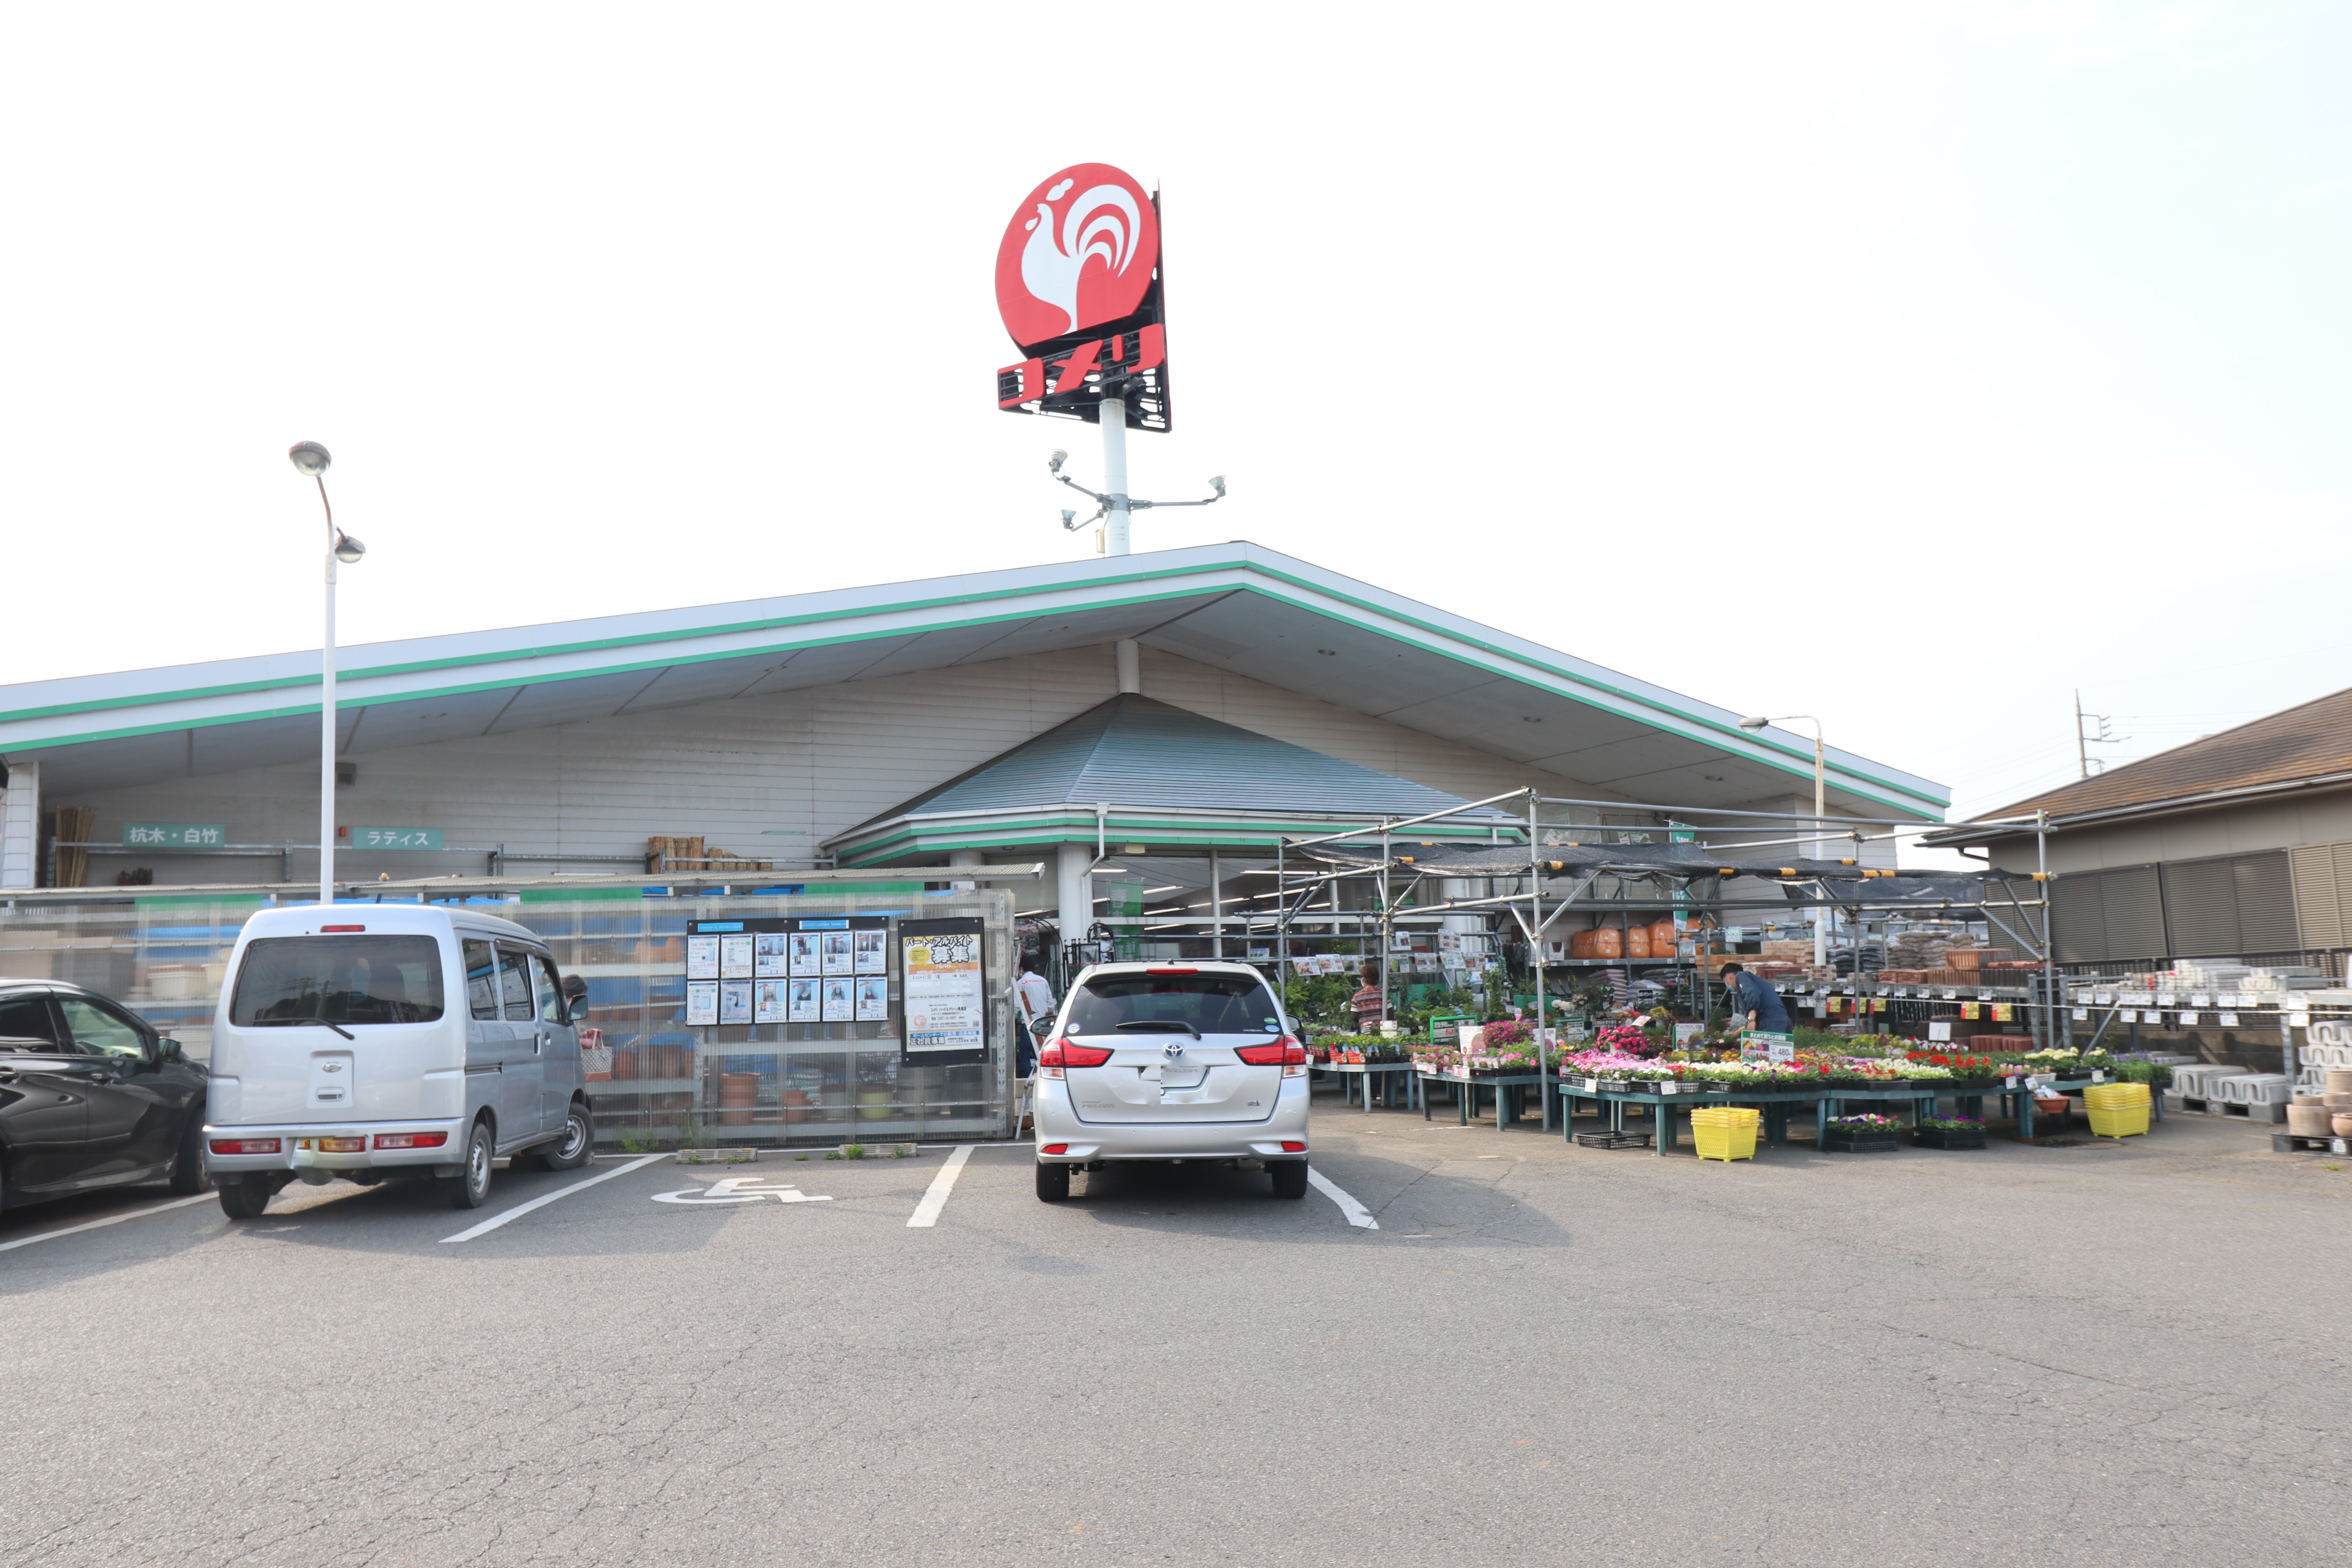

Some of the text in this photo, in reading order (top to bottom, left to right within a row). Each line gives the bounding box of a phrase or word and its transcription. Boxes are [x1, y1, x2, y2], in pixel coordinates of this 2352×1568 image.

[997, 323, 1165, 408] コメリ
[130, 827, 218, 843] 杭木・白竹
[368, 831, 428, 846] ラティス
[906, 935, 973, 947] パート・アルバイト
[931, 944, 969, 964] 募集
[910, 1036, 946, 1046] 正社員募集
